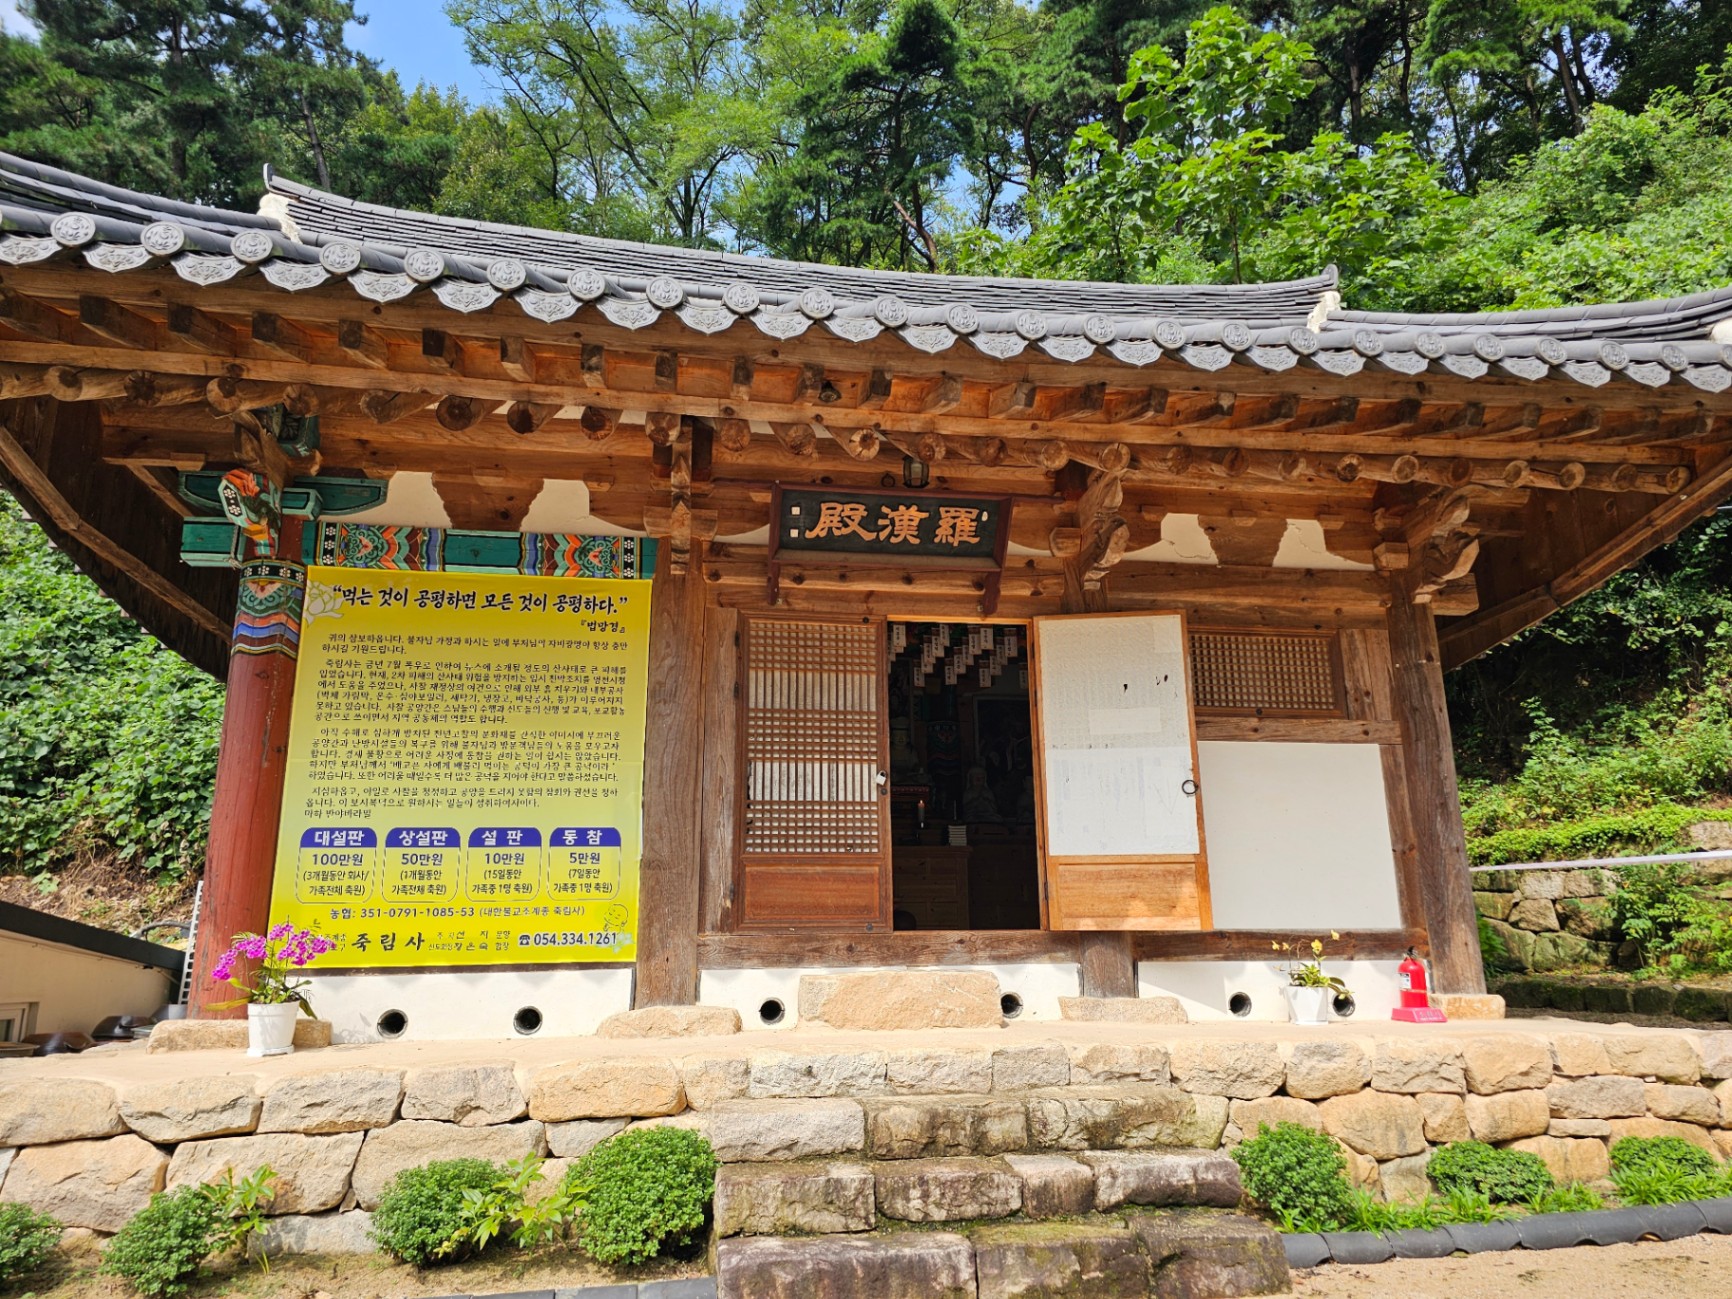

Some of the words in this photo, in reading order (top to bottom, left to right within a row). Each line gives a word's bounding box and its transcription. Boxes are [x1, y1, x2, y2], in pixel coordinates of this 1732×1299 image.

[805, 501, 980, 547] 羅漢殿
[378, 587, 408, 607] 것이
[413, 589, 476, 609] 공평하면
[481, 592, 513, 611] 모든
[518, 593, 547, 612] 것이
[314, 830, 365, 847] 대설판
[399, 830, 448, 847] 상설판
[312, 853, 364, 866] 100만원
[401, 853, 443, 866] 50만원
[484, 852, 525, 865] 10만원
[569, 852, 600, 865] 5만원
[303, 870, 346, 881] (3개월동안
[348, 870, 369, 881] 회사/
[400, 870, 442, 881] (1개월동안
[484, 869, 522, 880] (15일동안
[568, 868, 600, 879] (7일동안
[309, 885, 343, 896] 가족전체
[345, 884, 365, 896] 축원)
[392, 885, 425, 896] 가족전체
[427, 884, 447, 895] 축원)
[472, 884, 497, 895] 가족중
[499, 883, 511, 894] 1명
[513, 883, 533, 894] 축원)
[553, 883, 577, 894] 가족중
[579, 883, 591, 893] 1명
[594, 882, 613, 894] 축원)
[330, 908, 356, 919] 농협:
[360, 908, 475, 918] 351-0791-1085-53
[553, 905, 585, 916] 죽림사)
[533, 932, 617, 946] 054.334.1261
